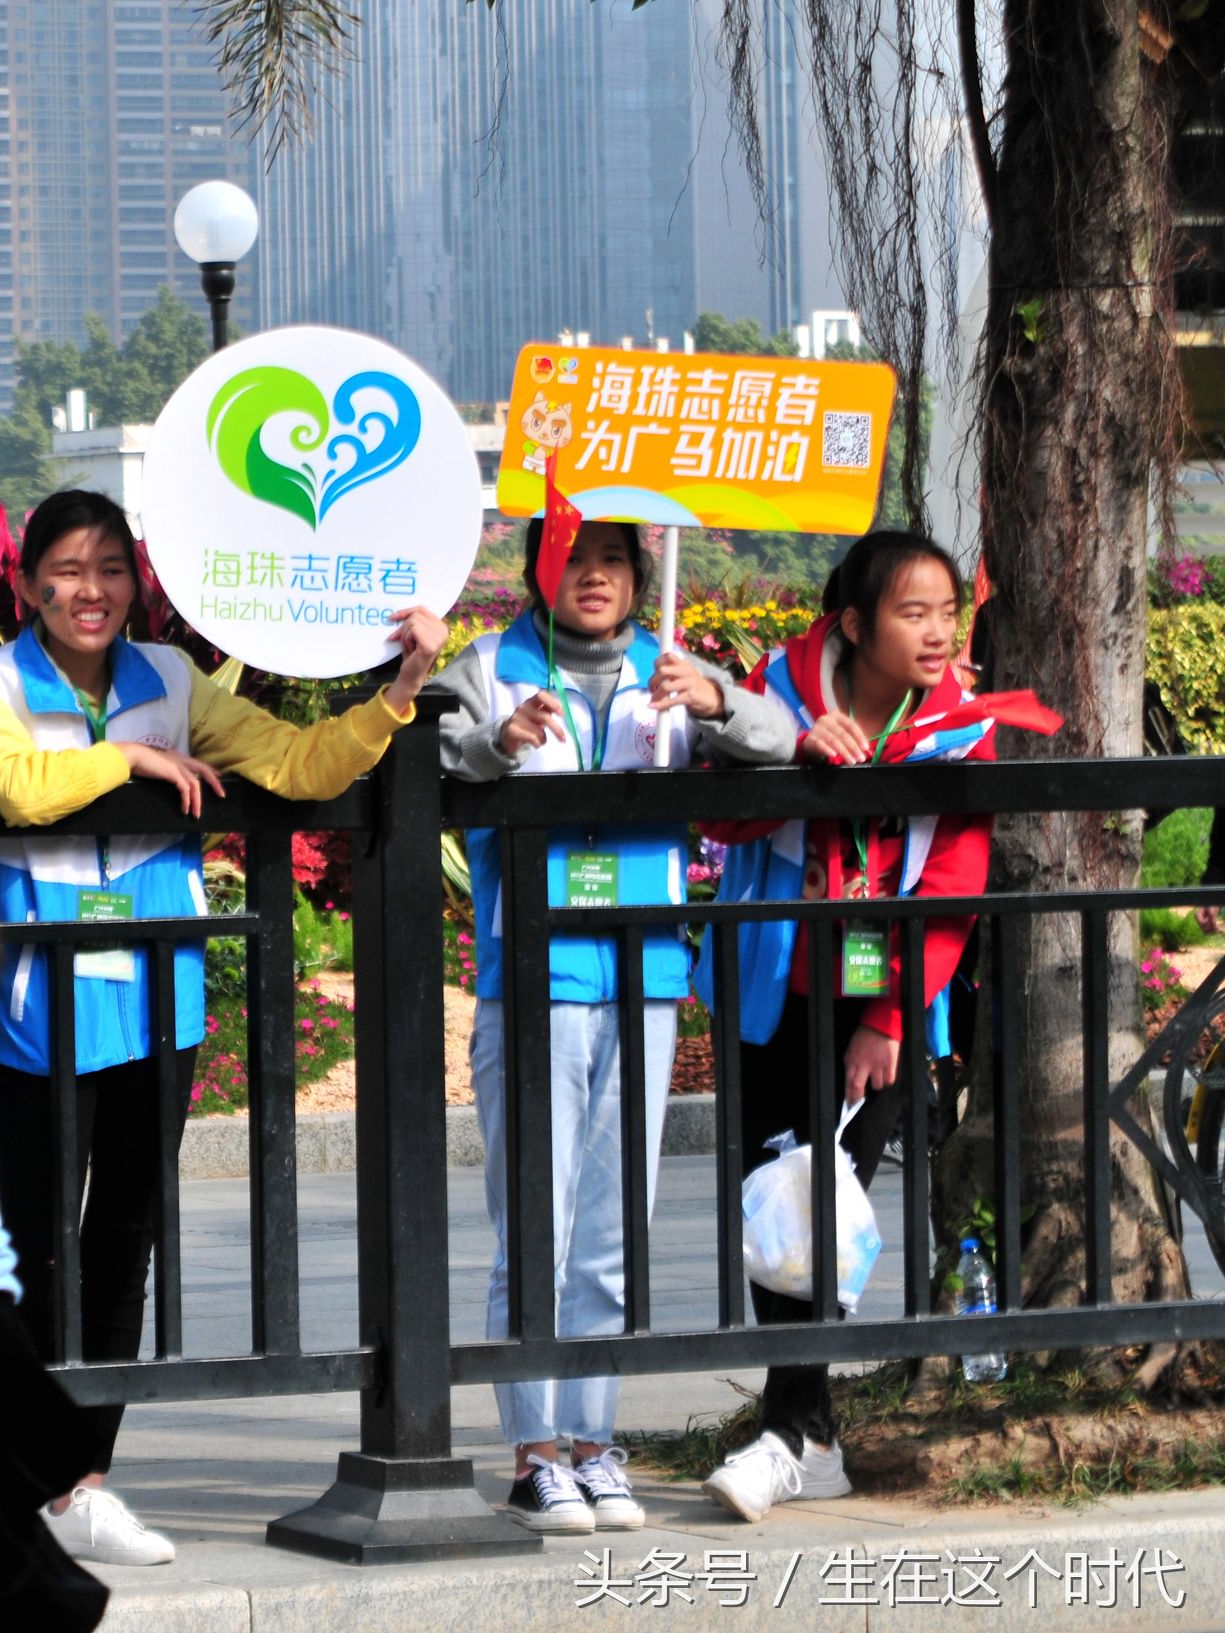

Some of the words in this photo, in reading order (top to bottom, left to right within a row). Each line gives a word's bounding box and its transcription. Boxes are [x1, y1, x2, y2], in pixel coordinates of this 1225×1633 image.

[586, 361, 821, 426] 海珠志愿者
[574, 419, 810, 483] 为广马加油
[202, 549, 418, 595] 海珠志愿者
[200, 594, 283, 623] Haizhu
[287, 599, 400, 627] Voluntee
